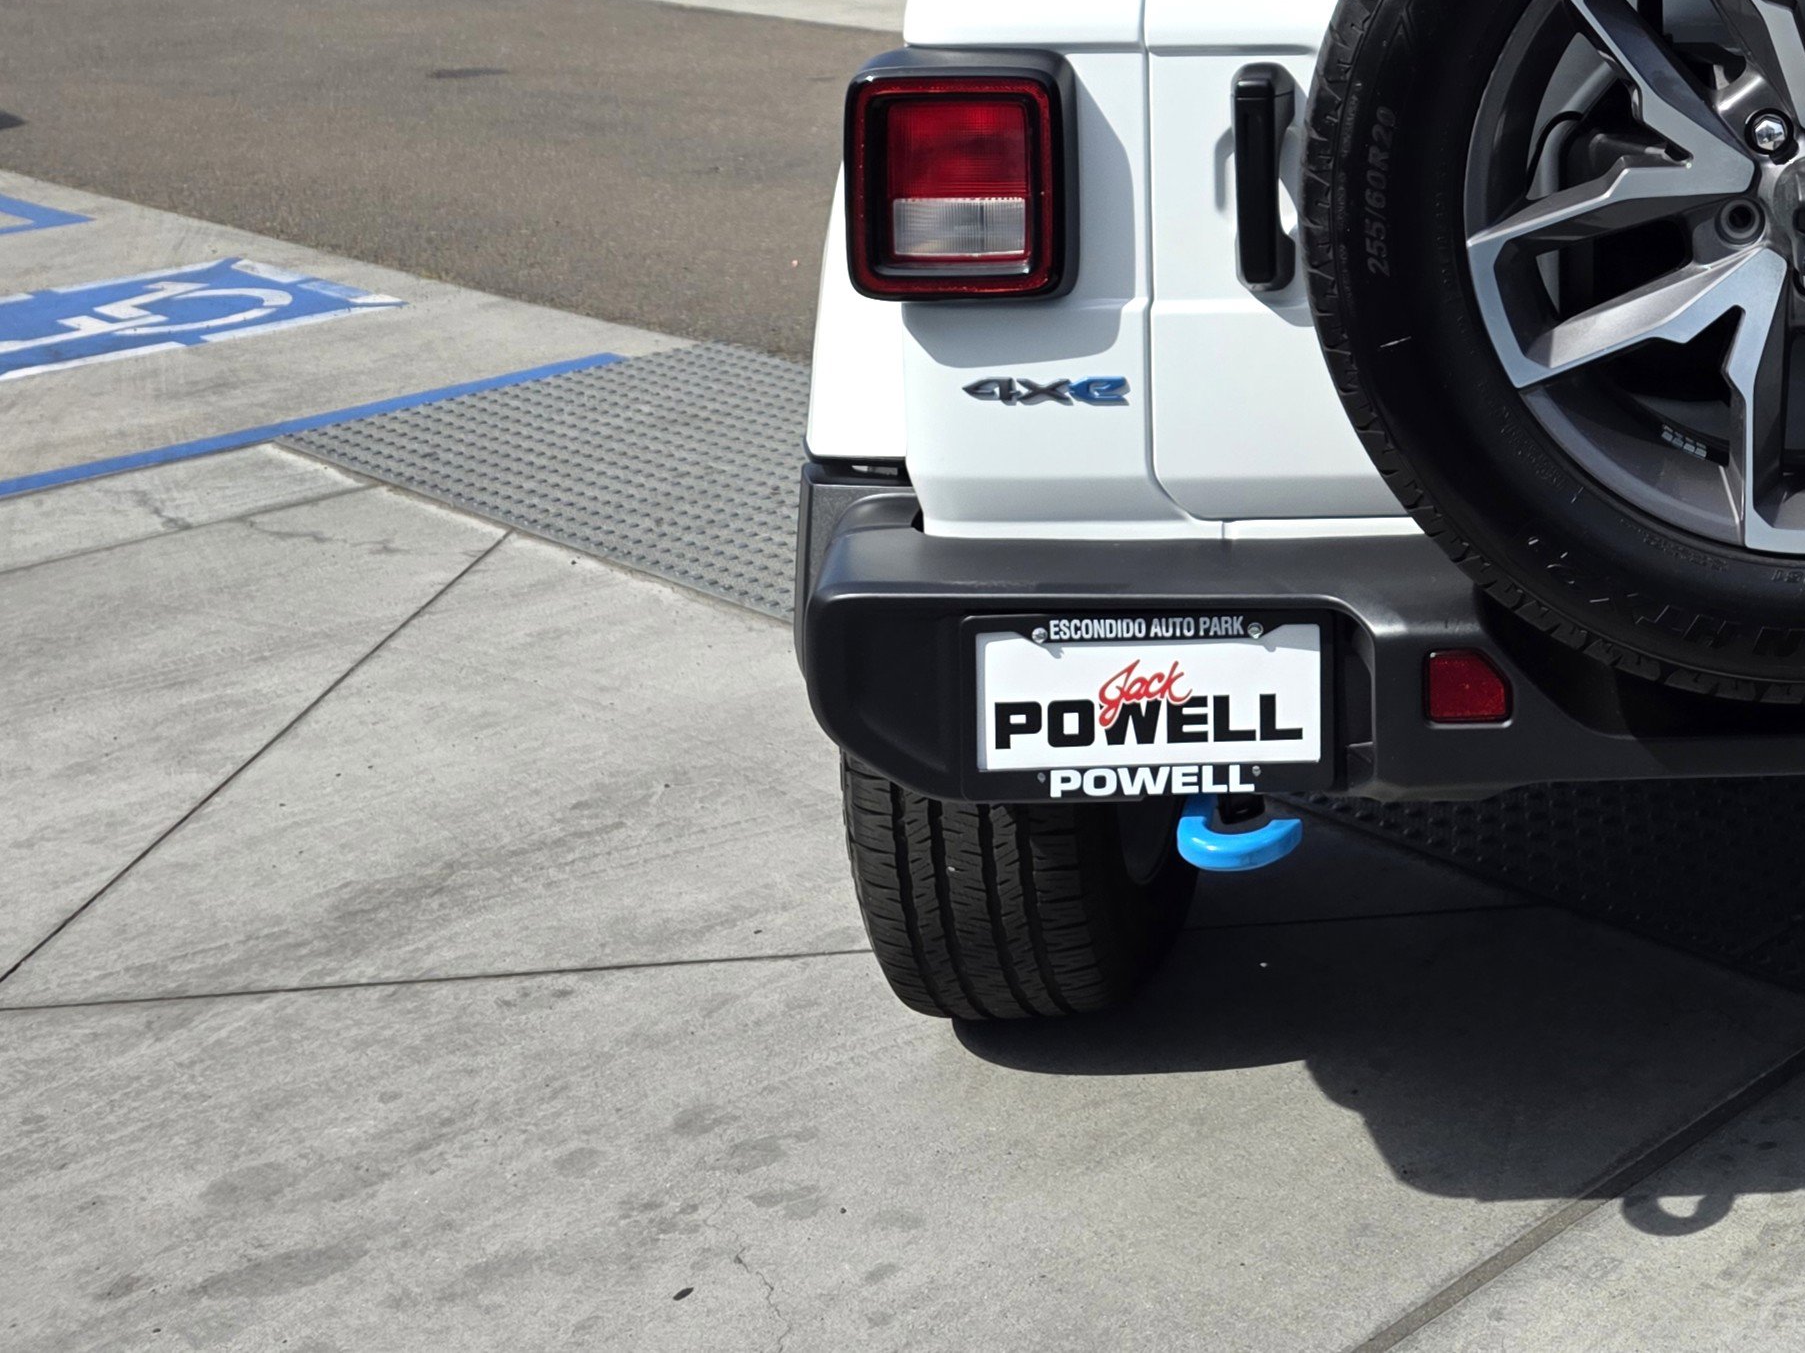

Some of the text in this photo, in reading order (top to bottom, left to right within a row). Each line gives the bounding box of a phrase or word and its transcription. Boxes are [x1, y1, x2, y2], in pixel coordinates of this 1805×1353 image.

[1363, 106, 1395, 278] 255/60R20
[1050, 616, 1244, 639] ESCONDIDO AUTO PARK
[995, 693, 1303, 750] POWELL
[1099, 659, 1193, 728] Jack
[1050, 764, 1255, 797] POWELL
